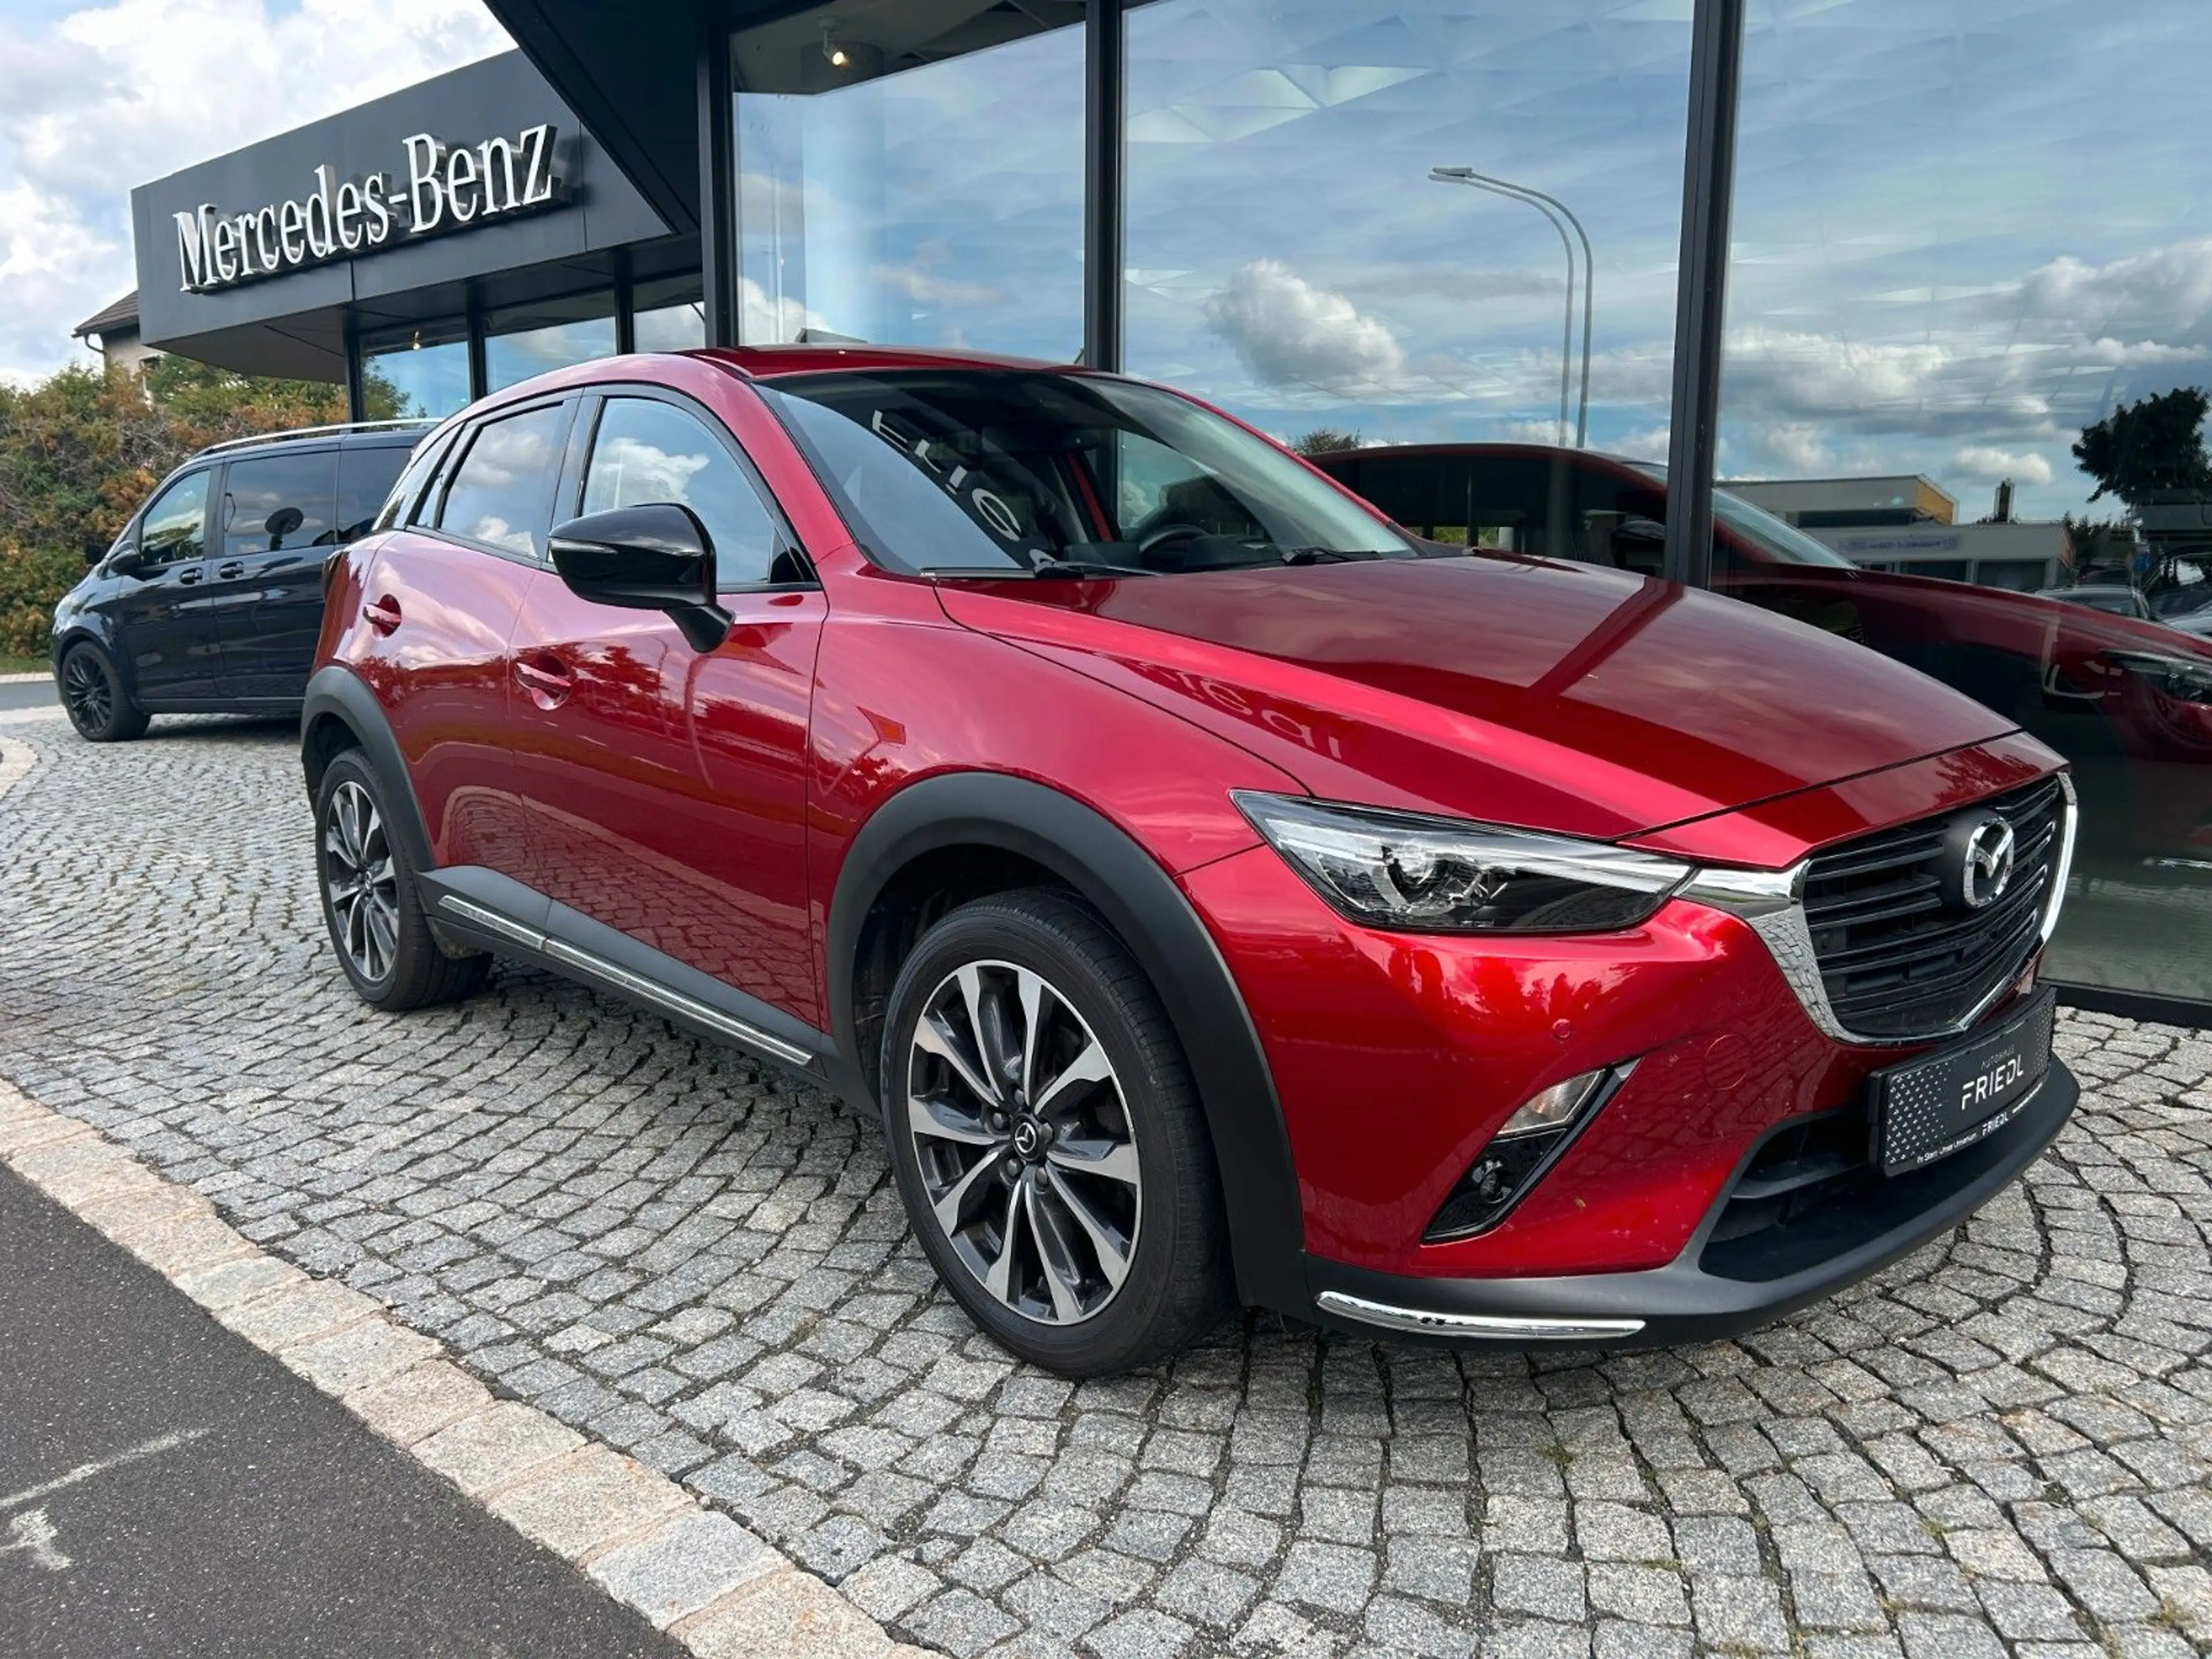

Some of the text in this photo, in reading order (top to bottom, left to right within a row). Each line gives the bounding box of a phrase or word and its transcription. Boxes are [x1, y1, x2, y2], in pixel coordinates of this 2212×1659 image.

[173, 123, 554, 293] Mercedes-Benz
[1961, 1054, 2024, 1111] FRIEDL
[1982, 1112, 2009, 1136] FRIEDL
